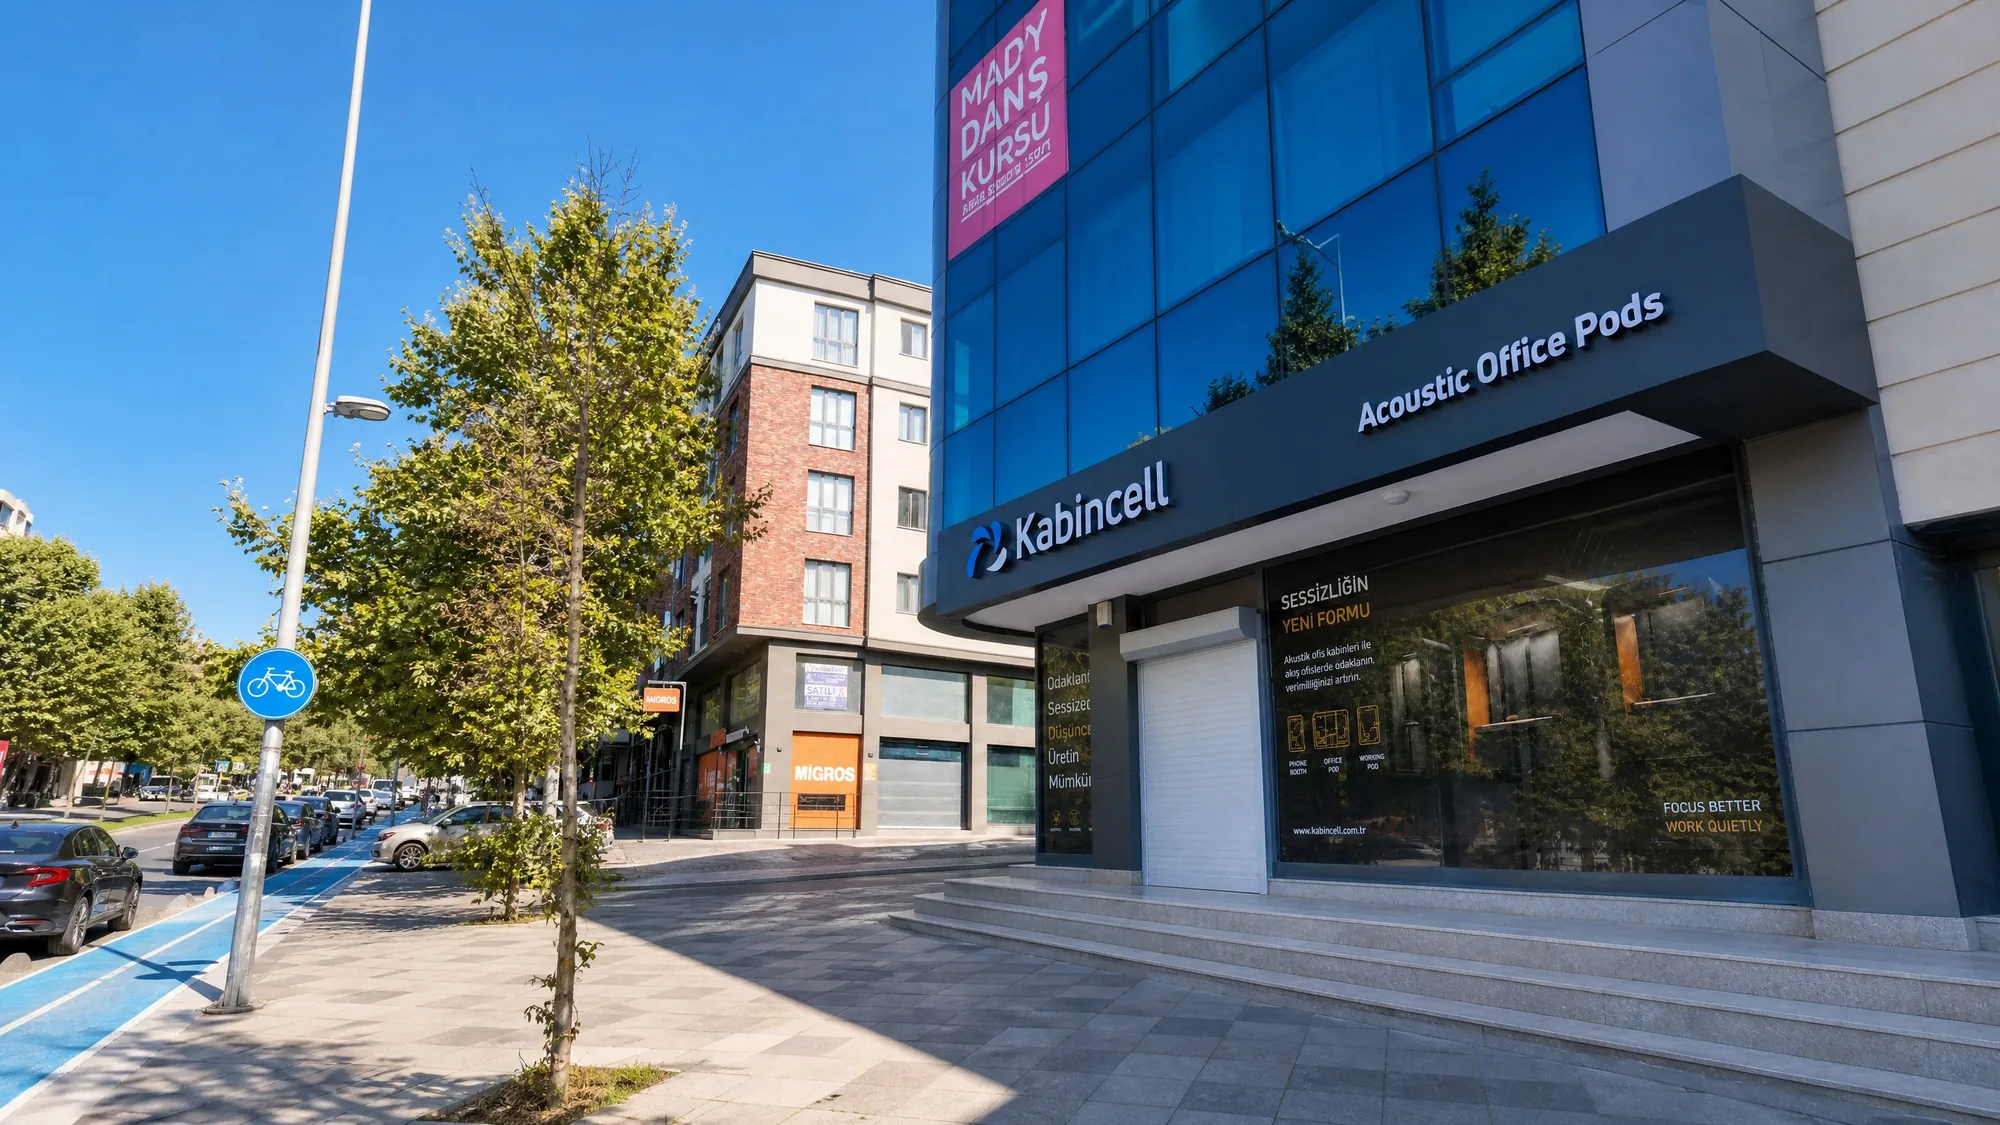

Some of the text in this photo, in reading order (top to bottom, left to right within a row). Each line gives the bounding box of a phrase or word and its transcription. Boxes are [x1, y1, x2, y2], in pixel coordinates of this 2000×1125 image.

[961, 8, 1048, 119] MADY
[961, 101, 1050, 200] KURSU
[1358, 291, 1665, 433] Acoustic Office Pods
[1016, 460, 1169, 560] Kabincell
[1281, 575, 1369, 610] SESSİZLİĞİN
[1282, 602, 1371, 634] YENİ FORMU
[1284, 640, 1372, 664] Akustik ofis kabinleri ile
[1301, 662, 1333, 676] ofislerde
[1048, 747, 1080, 765] Üretin
[1289, 759, 1308, 767] PHONE
[1323, 757, 1343, 765] OFFICE
[1663, 799, 1762, 814] FOCUS BETTER
[1292, 826, 1367, 835] www.kabincell.com.tr
[1665, 819, 1763, 833] WORK QUIETLY
